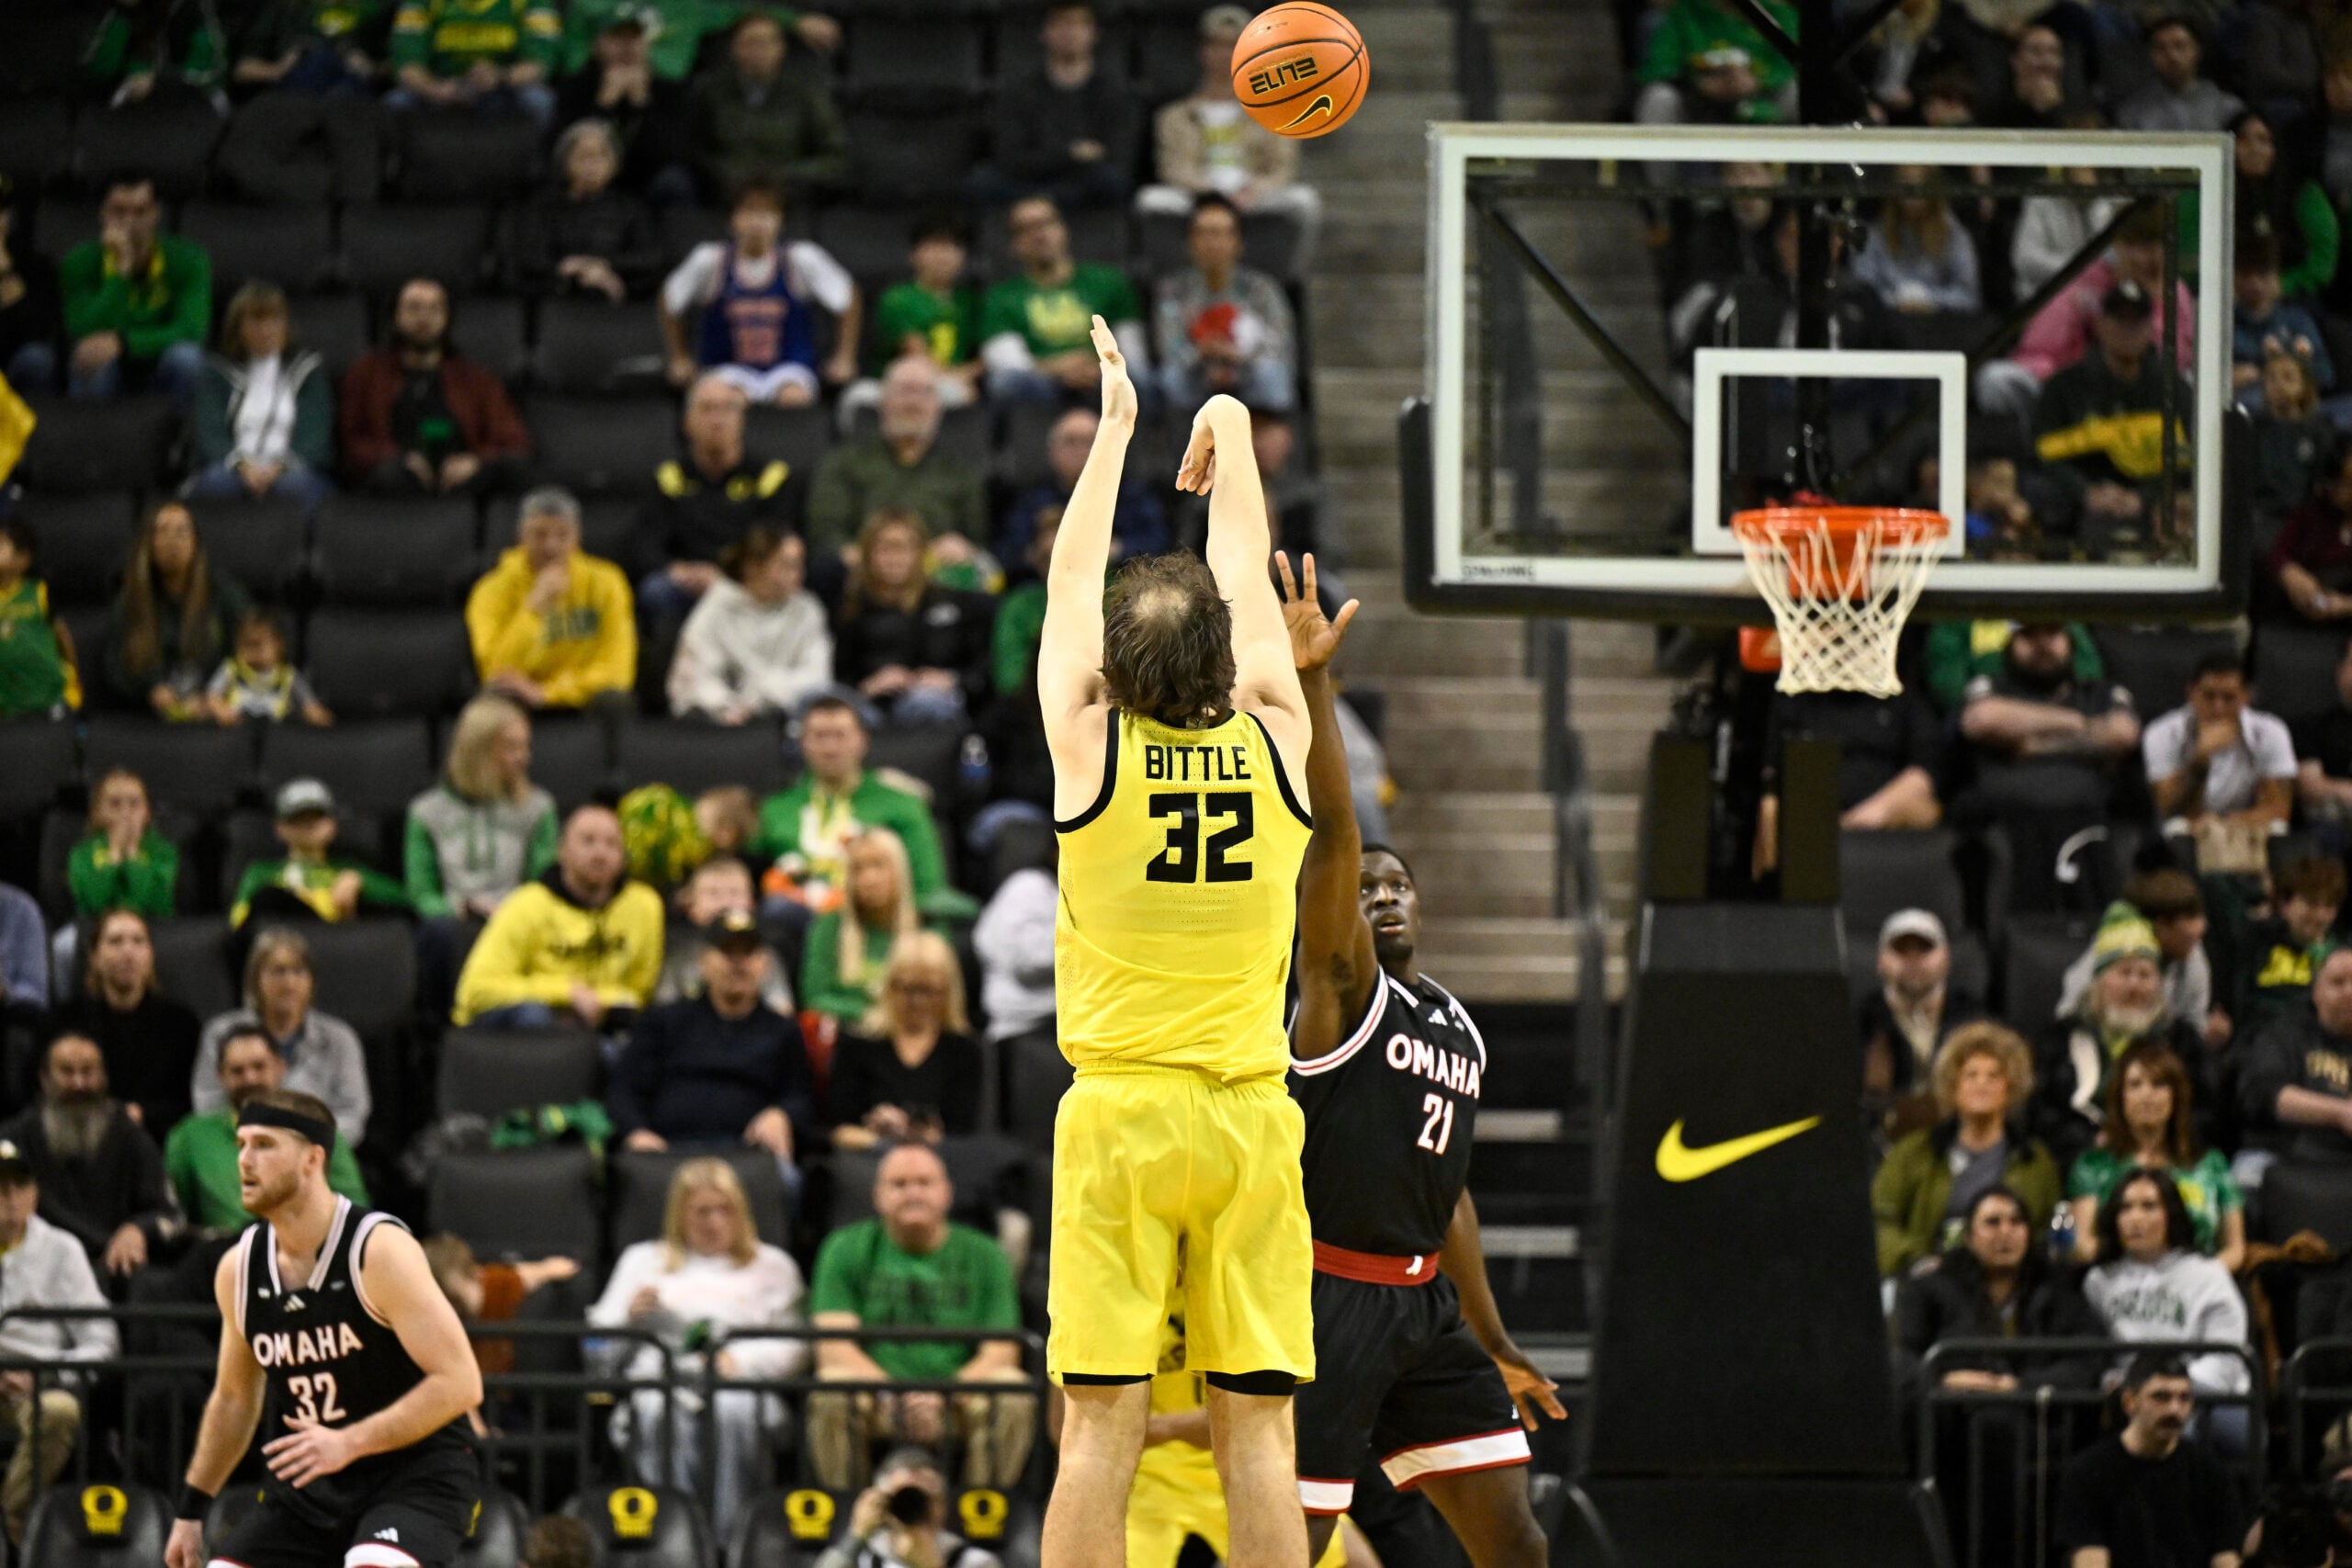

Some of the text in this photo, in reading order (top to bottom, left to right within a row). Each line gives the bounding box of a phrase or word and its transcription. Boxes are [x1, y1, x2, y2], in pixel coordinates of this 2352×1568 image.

[1250, 57, 1318, 95] ELITE
[1145, 745, 1251, 781] BITTLE
[1146, 792, 1254, 884] 32
[1385, 1032, 1481, 1100] OMAHA
[1417, 1092, 1454, 1156] 21
[253, 1322, 364, 1368] OMAHA
[288, 1371, 347, 1424] 32
